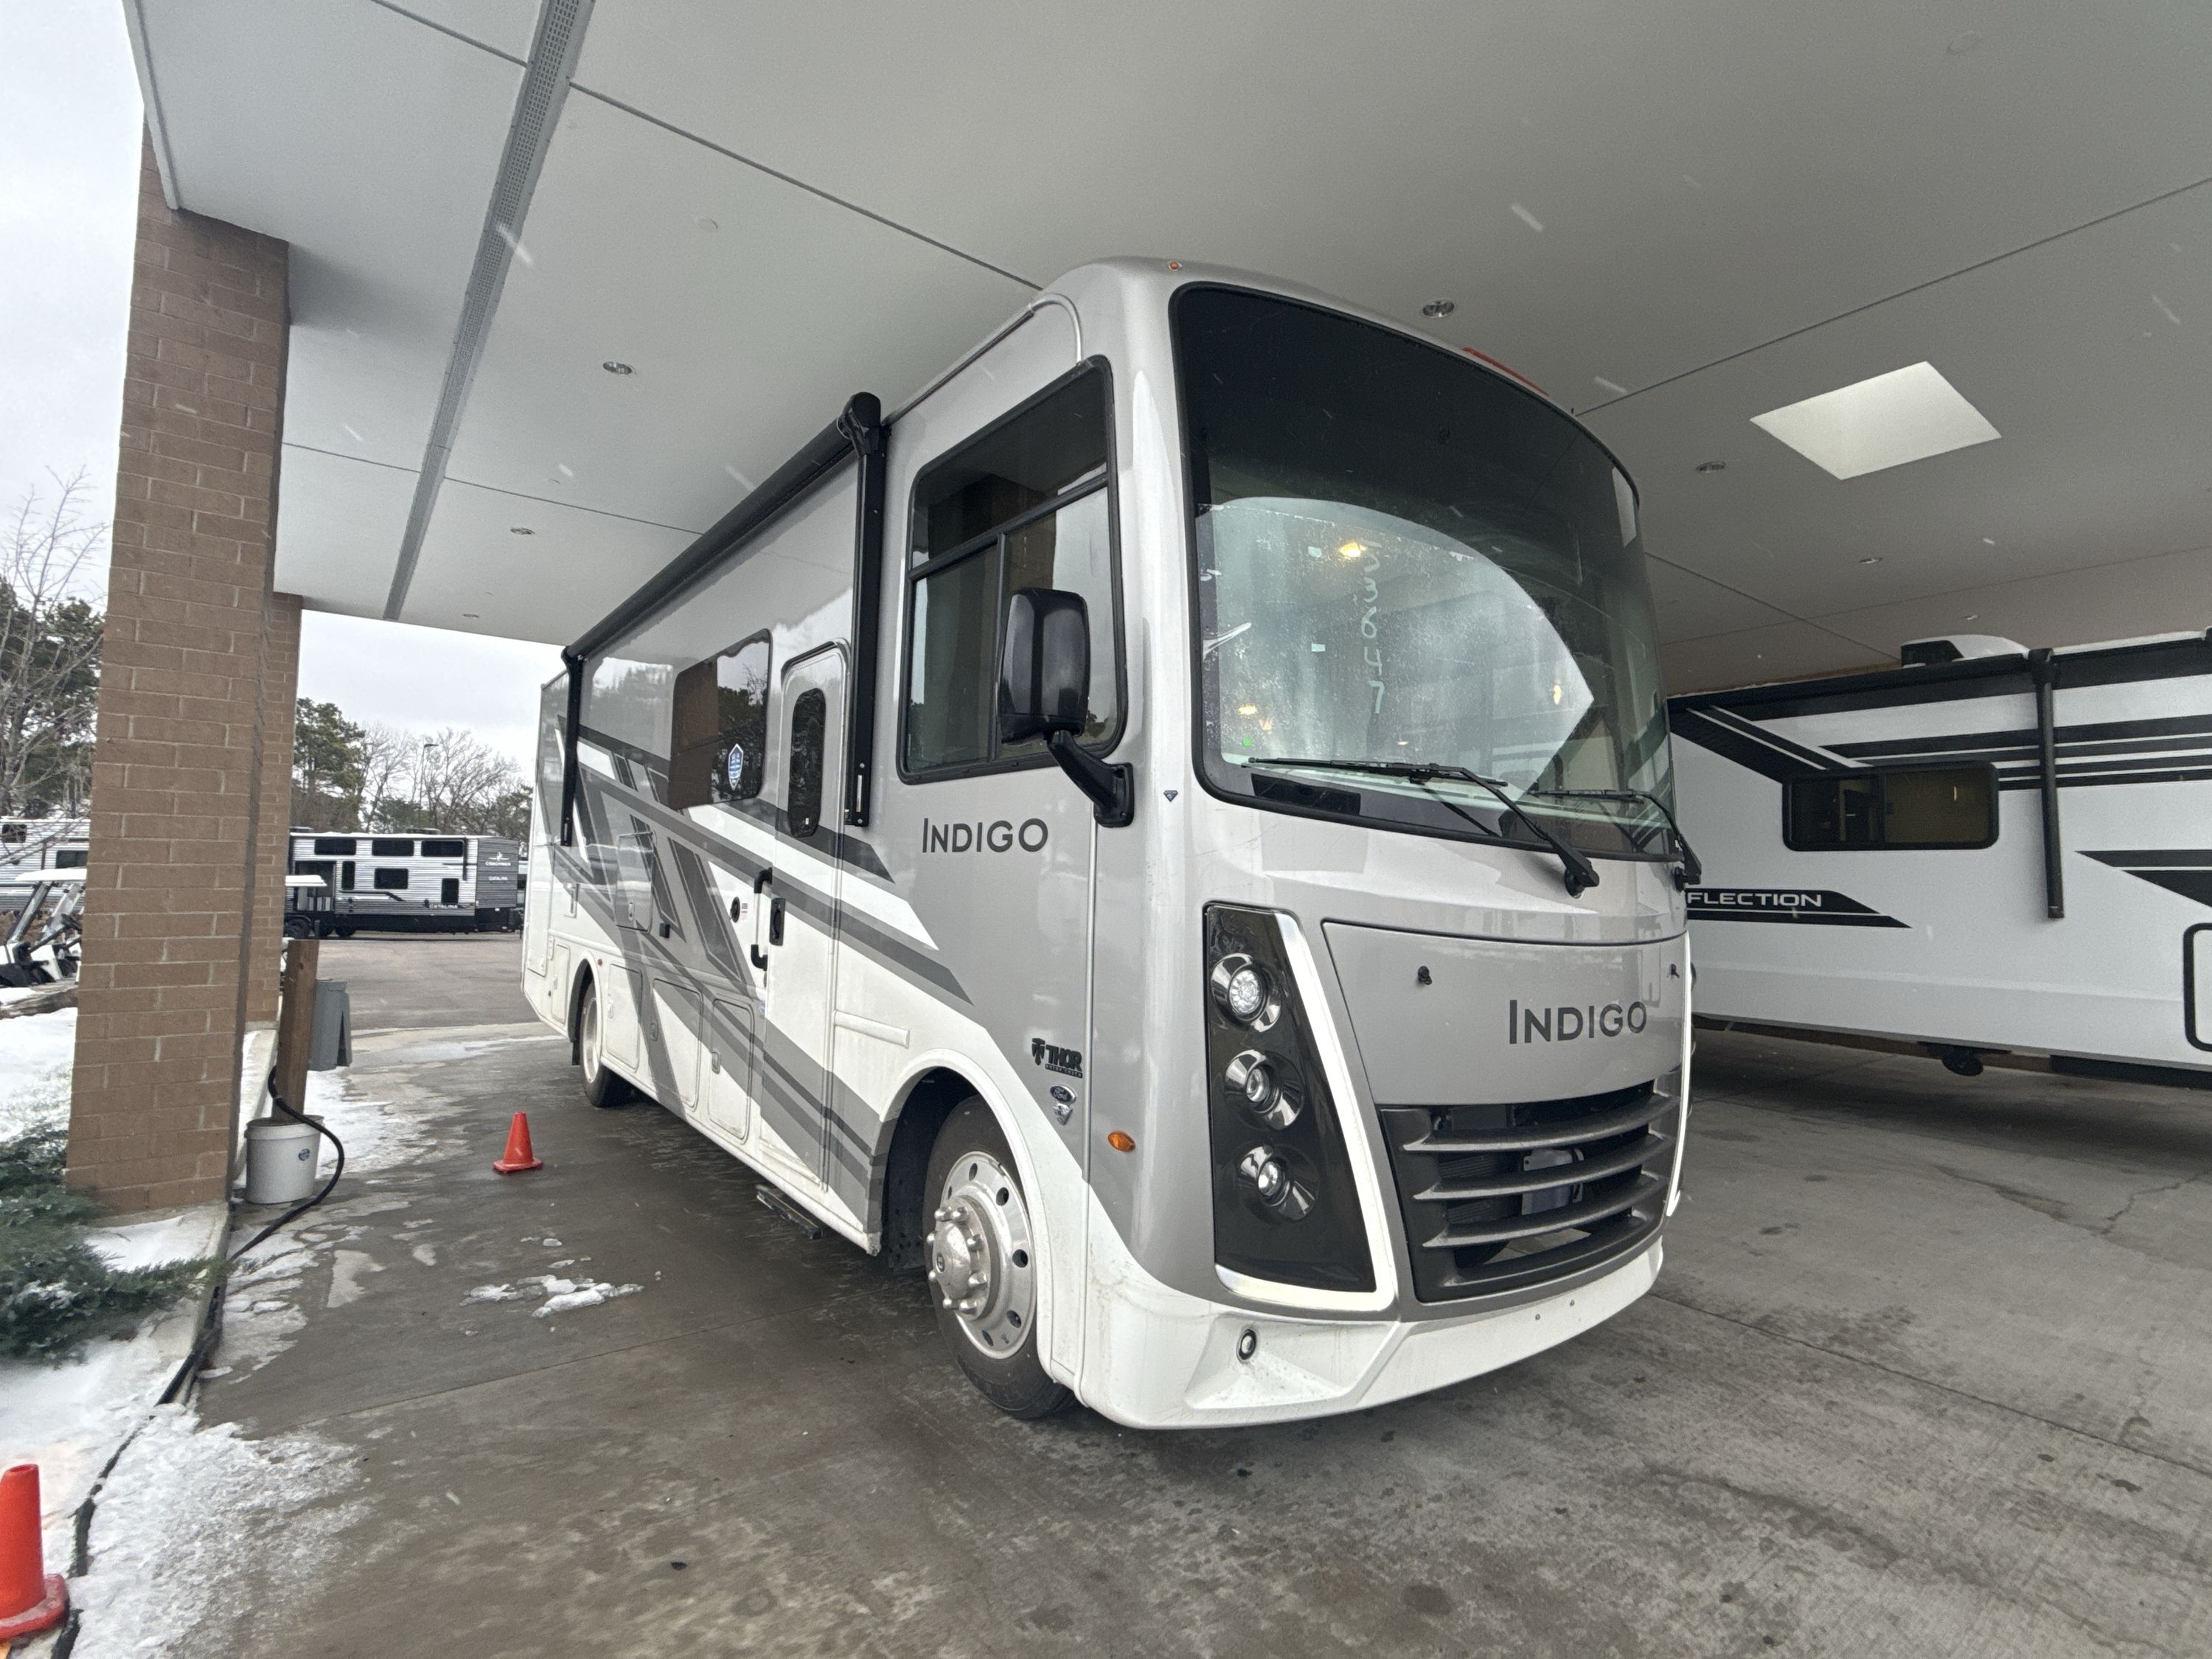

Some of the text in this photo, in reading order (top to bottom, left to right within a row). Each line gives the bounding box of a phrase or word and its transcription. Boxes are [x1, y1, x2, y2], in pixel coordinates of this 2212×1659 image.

[922, 818, 1048, 853] INDIGO
[1686, 892, 1822, 907] FLECTION
[1509, 999, 1647, 1045] INDIGO
[1046, 1044, 1082, 1072] THOR
